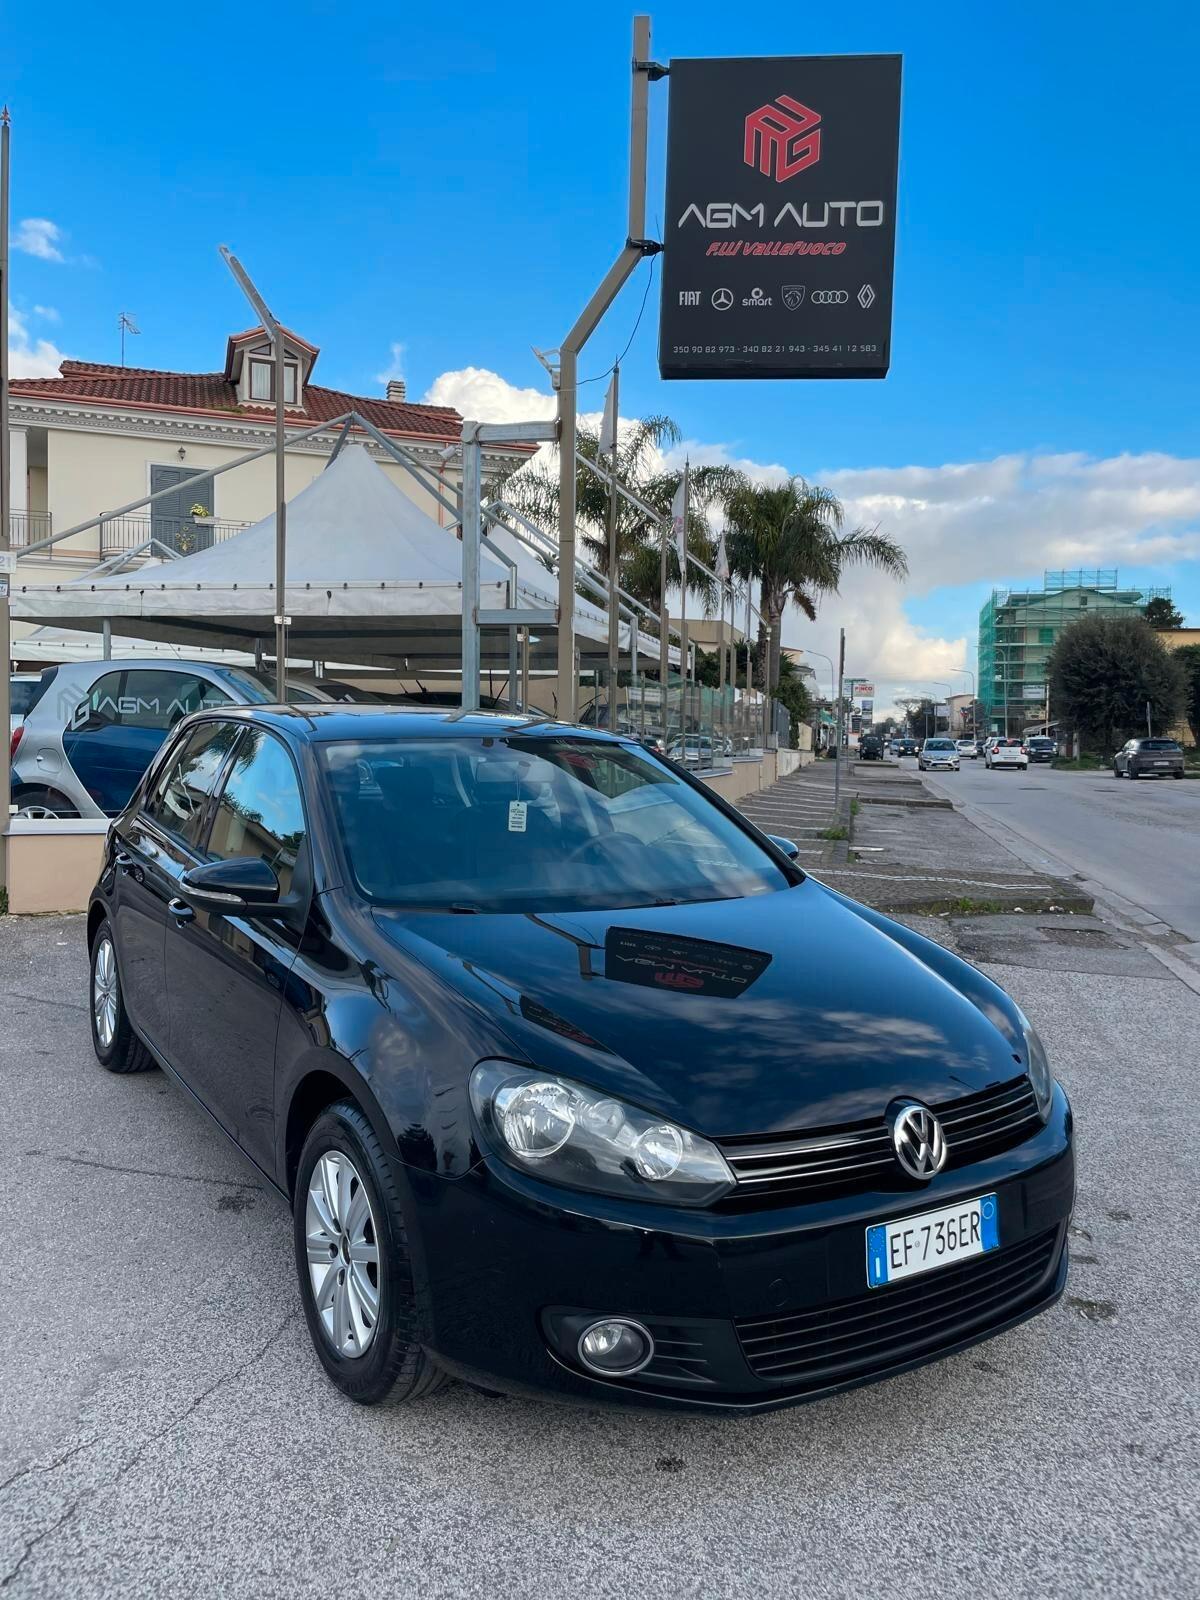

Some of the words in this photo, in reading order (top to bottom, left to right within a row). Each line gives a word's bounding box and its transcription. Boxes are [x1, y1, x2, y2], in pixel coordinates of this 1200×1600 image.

[678, 203, 764, 229] AGM
[774, 200, 884, 228] AUTO
[679, 291, 702, 306] FIAT
[742, 297, 773, 307] smart
[742, 345, 759, 353] 340
[761, 345, 773, 353] 82
[775, 345, 785, 353] 21
[98, 697, 160, 714] AGM
